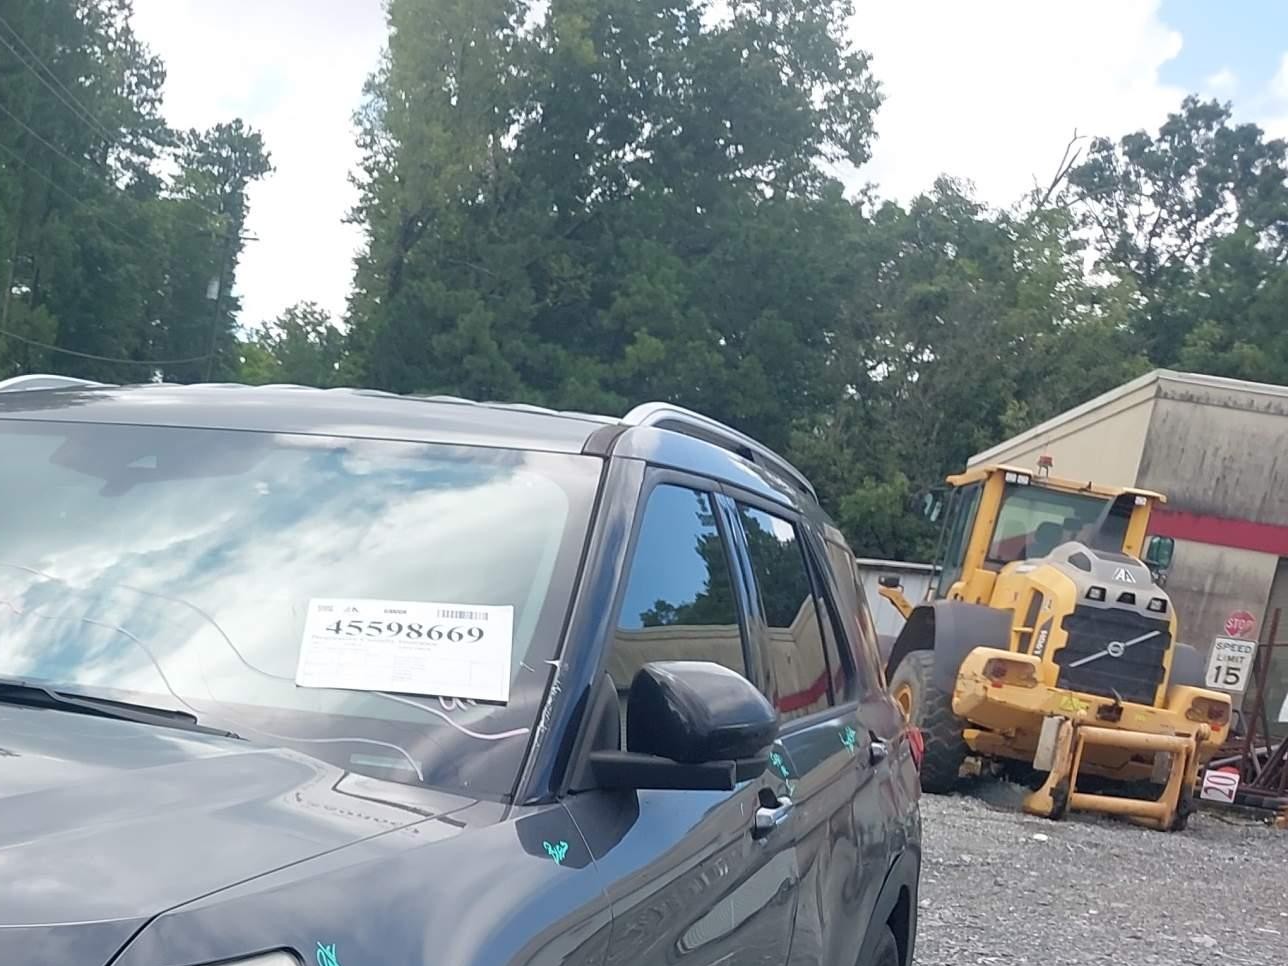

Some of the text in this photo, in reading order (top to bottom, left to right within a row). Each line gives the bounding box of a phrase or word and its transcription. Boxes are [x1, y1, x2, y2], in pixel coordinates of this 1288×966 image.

[325, 619, 485, 643] 45598669
[1215, 641, 1253, 654] SPEED
[1216, 654, 1246, 664] LIMIT
[1213, 665, 1241, 686] 15
